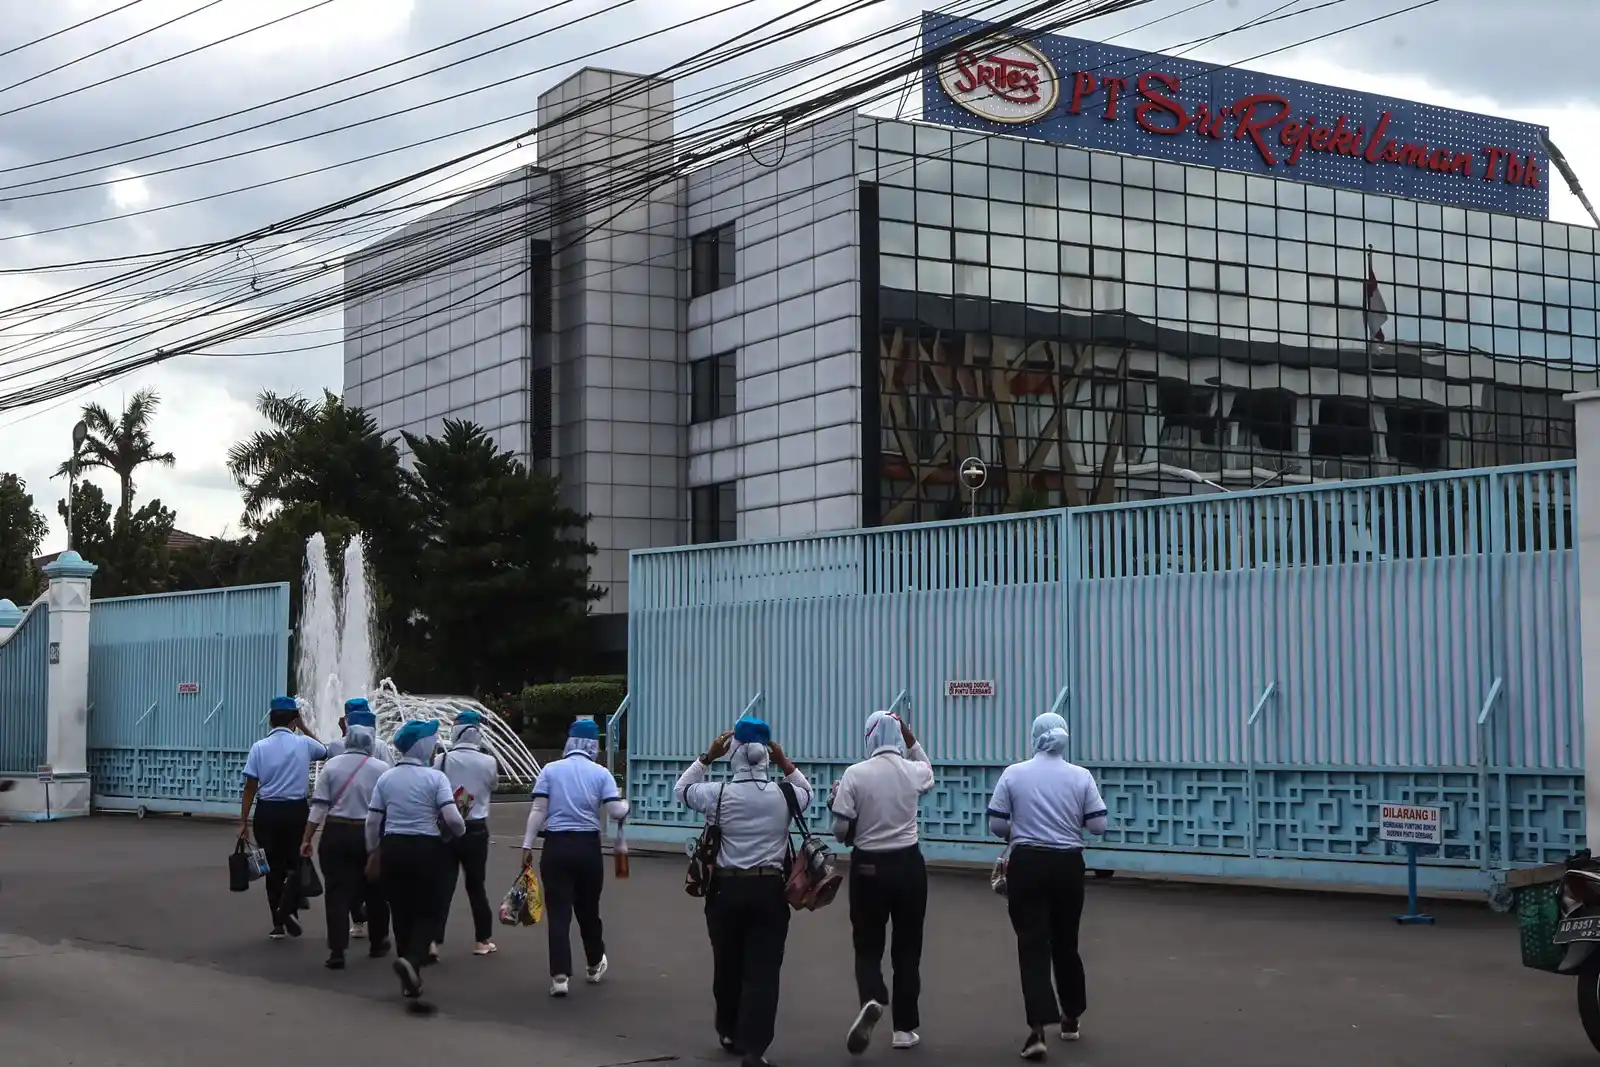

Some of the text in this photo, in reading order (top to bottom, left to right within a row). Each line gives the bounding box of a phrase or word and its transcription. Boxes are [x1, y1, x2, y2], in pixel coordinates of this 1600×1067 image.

[1067, 71, 1541, 188] PT Sri Rejeki Isman Tbk
[1383, 807, 1428, 820] DILARANG
[1561, 921, 1571, 931] AD
